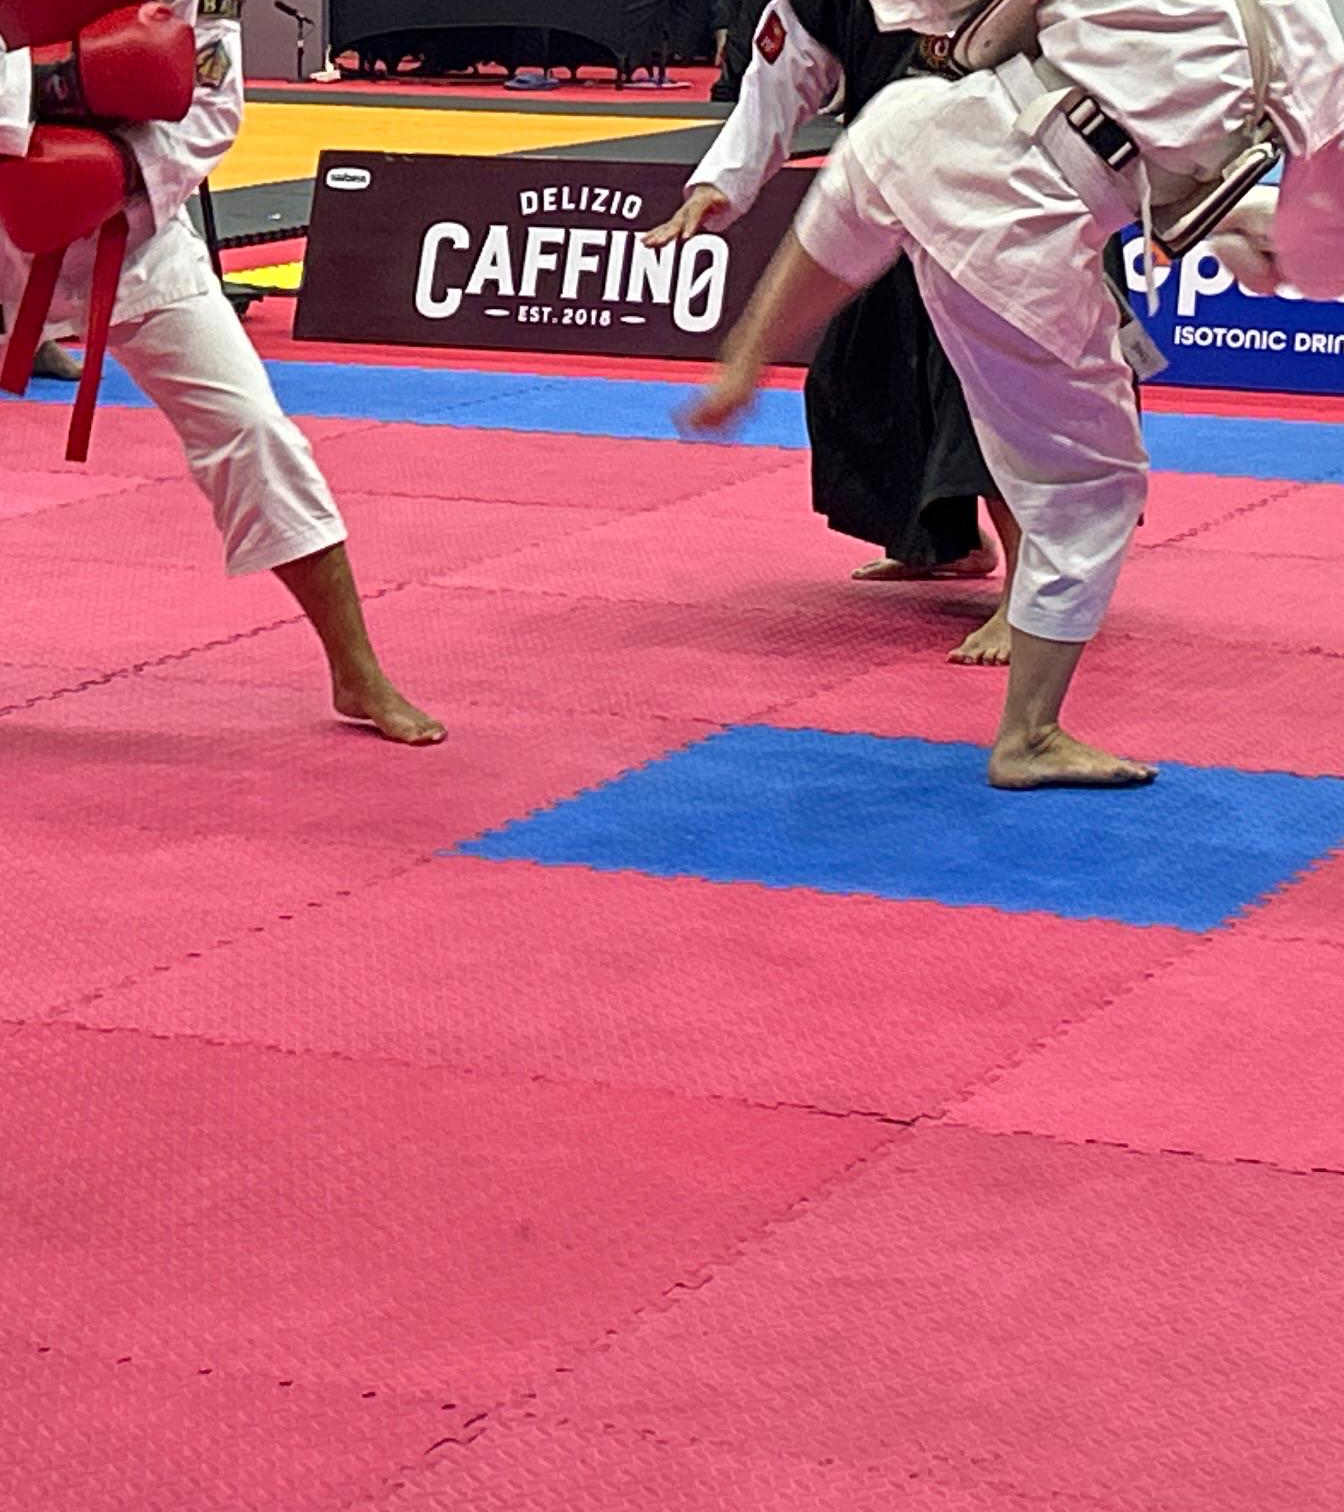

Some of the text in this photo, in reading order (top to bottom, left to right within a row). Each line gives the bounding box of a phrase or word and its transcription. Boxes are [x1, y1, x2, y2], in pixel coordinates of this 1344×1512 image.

[520, 186, 643, 220] DELIZIO
[414, 221, 730, 333] CAFFINO
[562, 307, 612, 326] 2018
[1173, 324, 1288, 351] ISOTONIC
